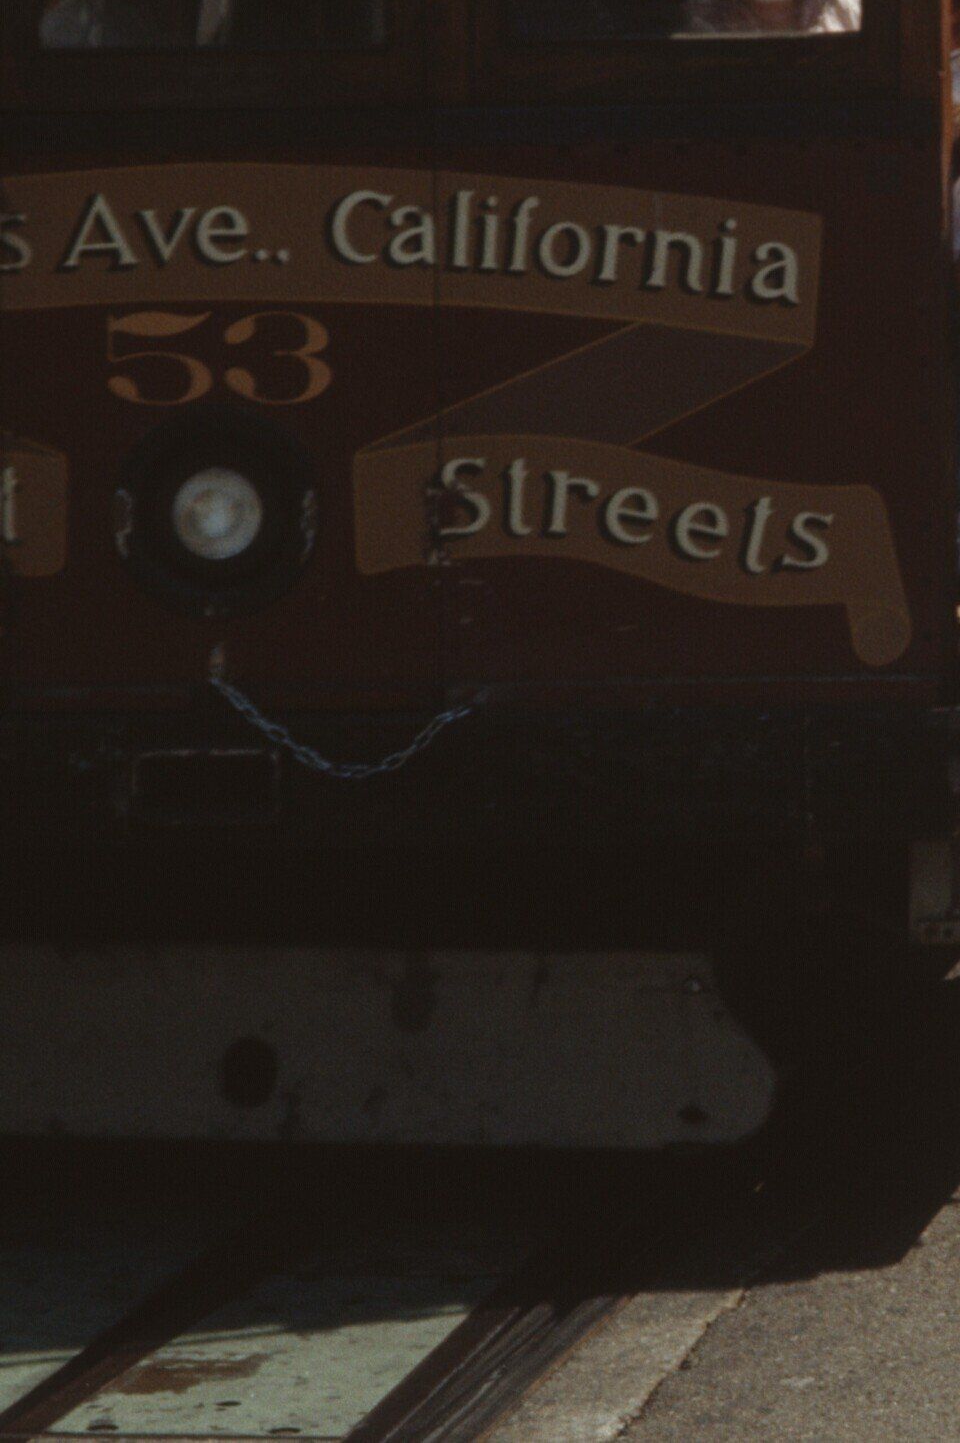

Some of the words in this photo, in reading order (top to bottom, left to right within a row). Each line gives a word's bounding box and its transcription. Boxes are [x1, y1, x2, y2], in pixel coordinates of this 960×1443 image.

[332, 189, 800, 304] California
[106, 310, 333, 406] 53
[438, 456, 836, 574] Streets
